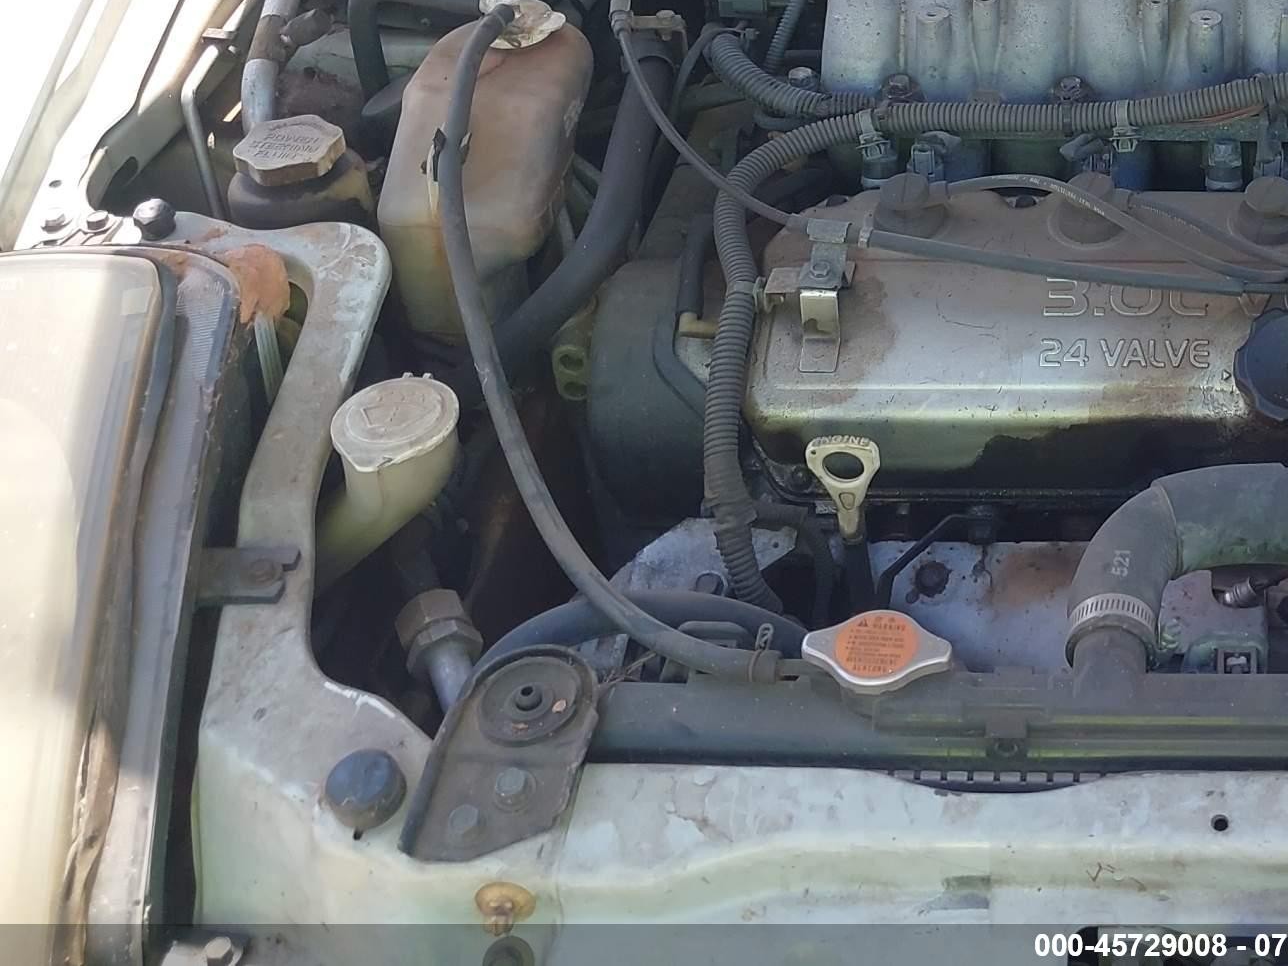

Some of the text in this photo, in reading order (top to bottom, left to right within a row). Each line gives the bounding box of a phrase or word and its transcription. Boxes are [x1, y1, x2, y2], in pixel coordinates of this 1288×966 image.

[1038, 338, 1211, 369] 24 VALVE
[811, 434, 871, 447] ENGINE
[1110, 549, 1132, 578] 521
